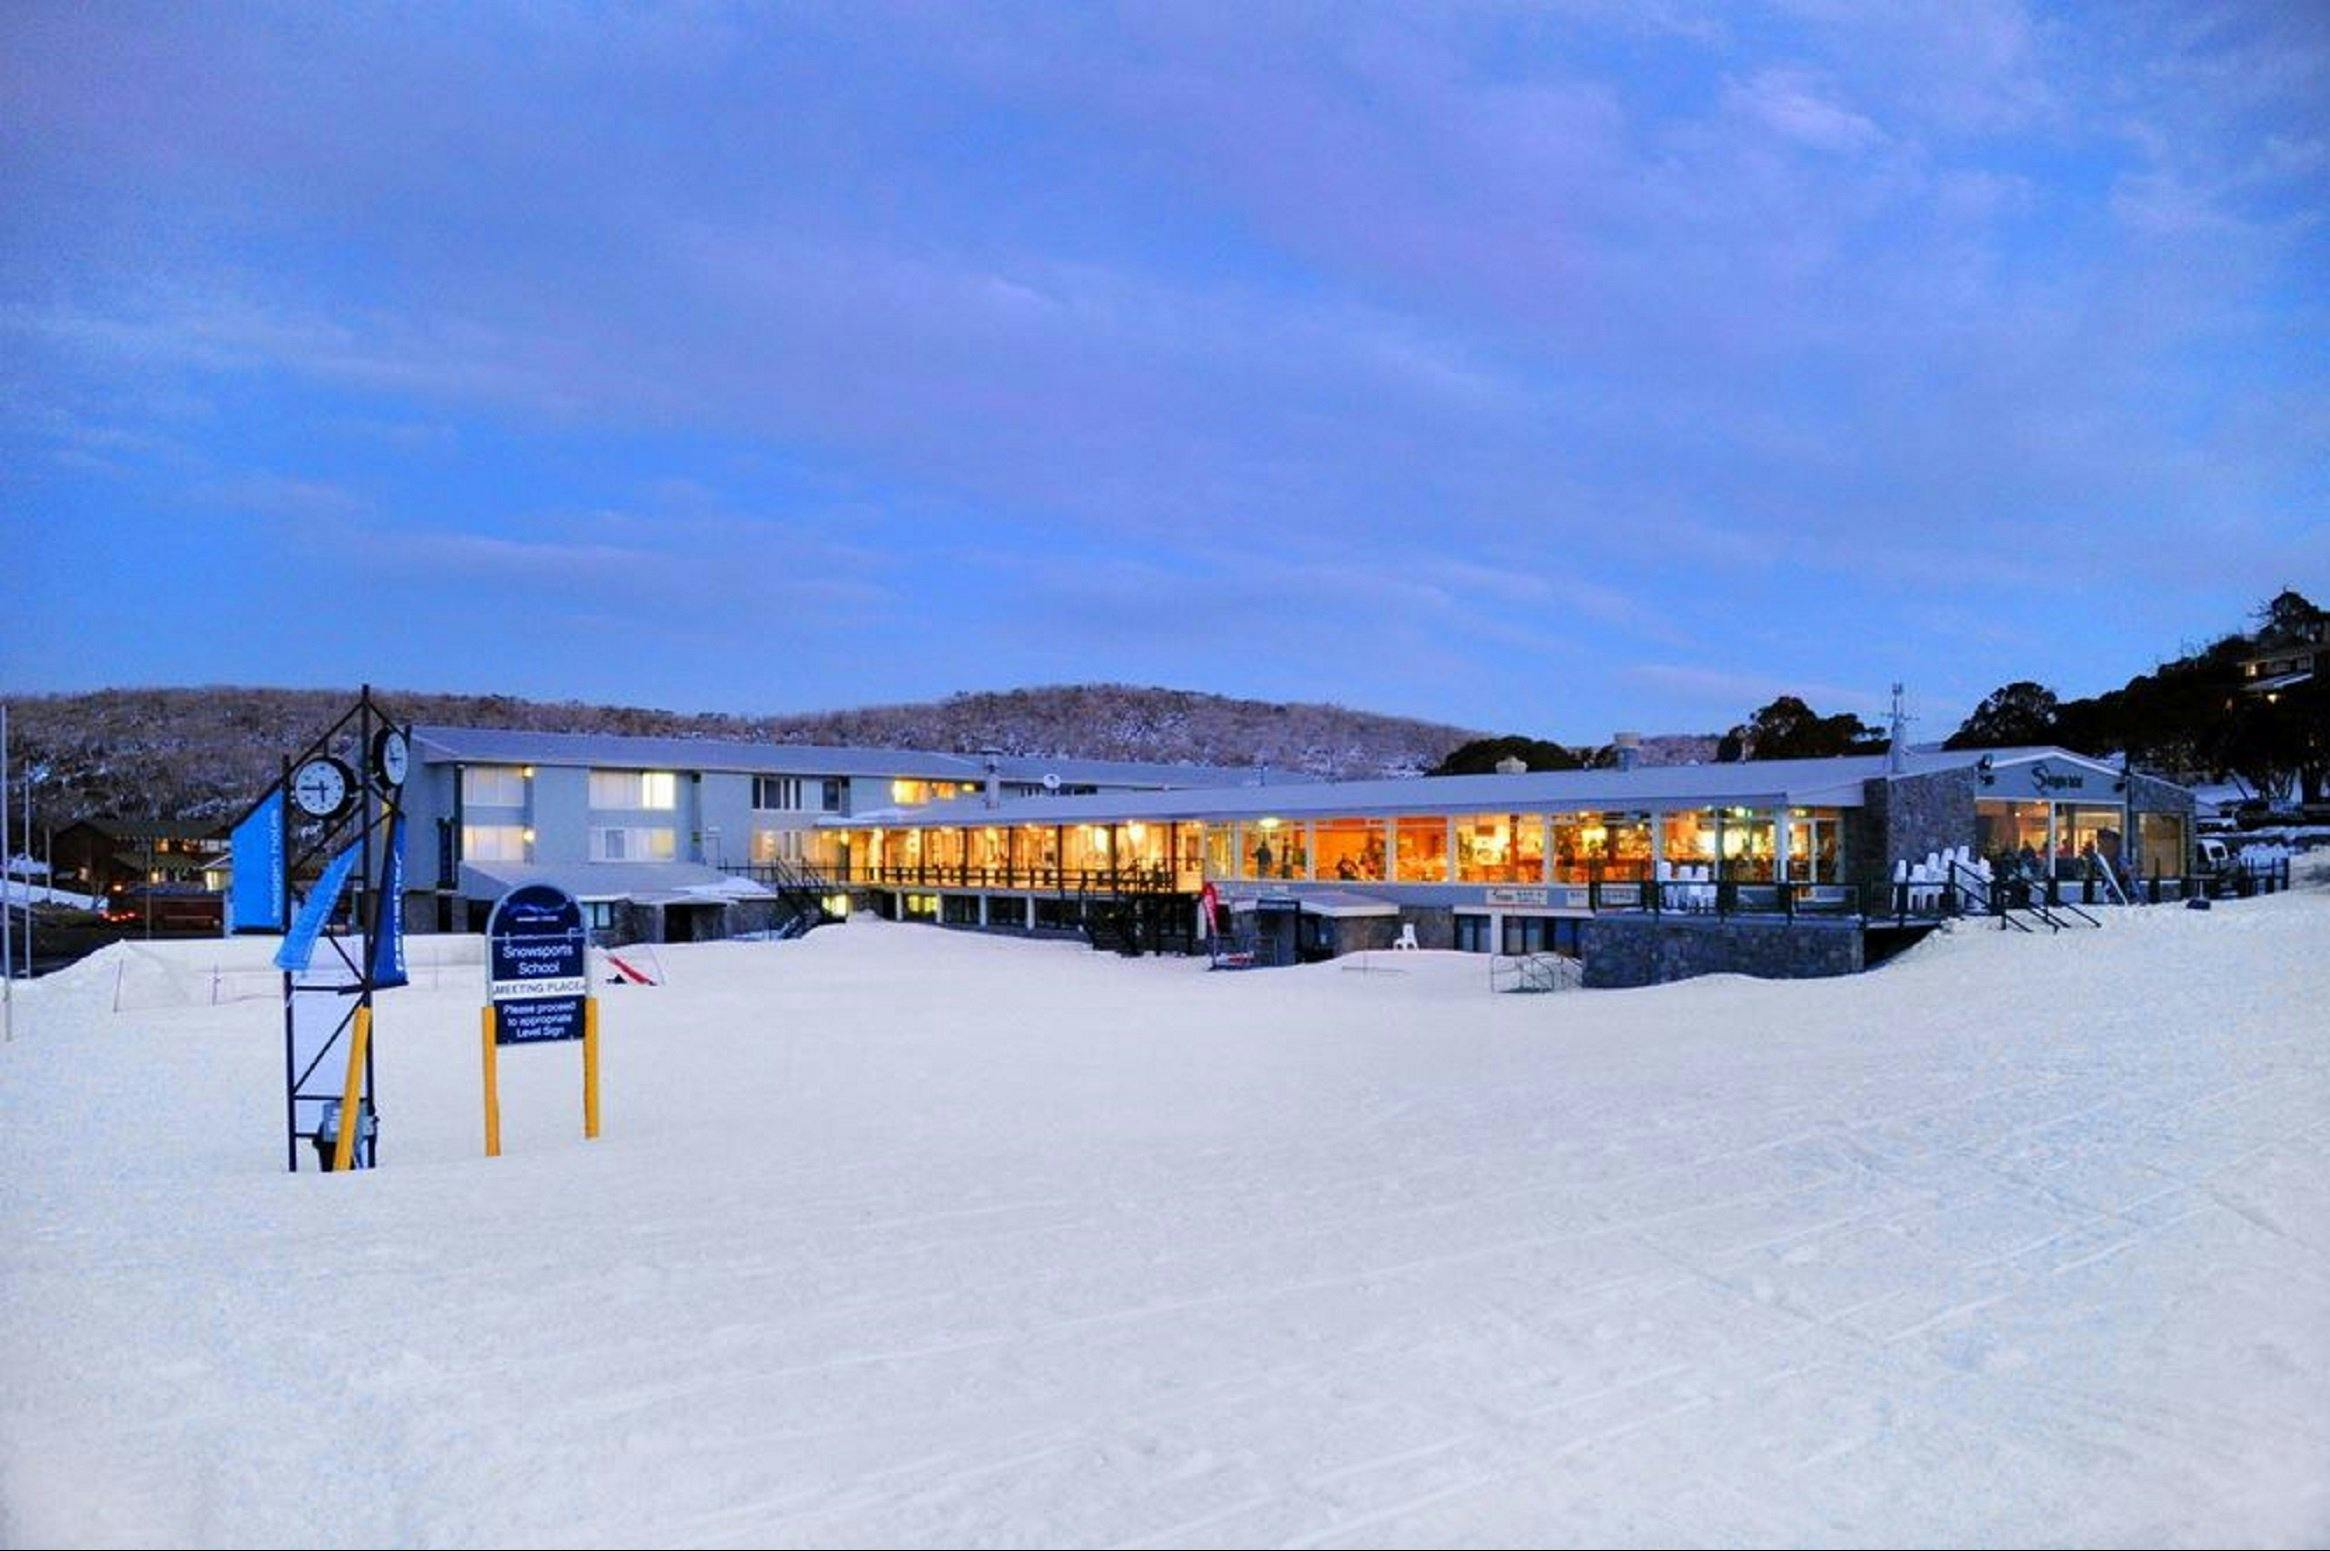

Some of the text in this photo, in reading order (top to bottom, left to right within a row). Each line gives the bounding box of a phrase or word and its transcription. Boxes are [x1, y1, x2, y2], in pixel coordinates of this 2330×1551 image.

[502, 944, 574, 960] Snowsports
[518, 961, 560, 975] School
[496, 983, 544, 995] MEETING
[503, 1001, 576, 1015] Please proceed
[507, 1014, 572, 1027] to appropriate
[516, 1025, 565, 1038] Level Sign
